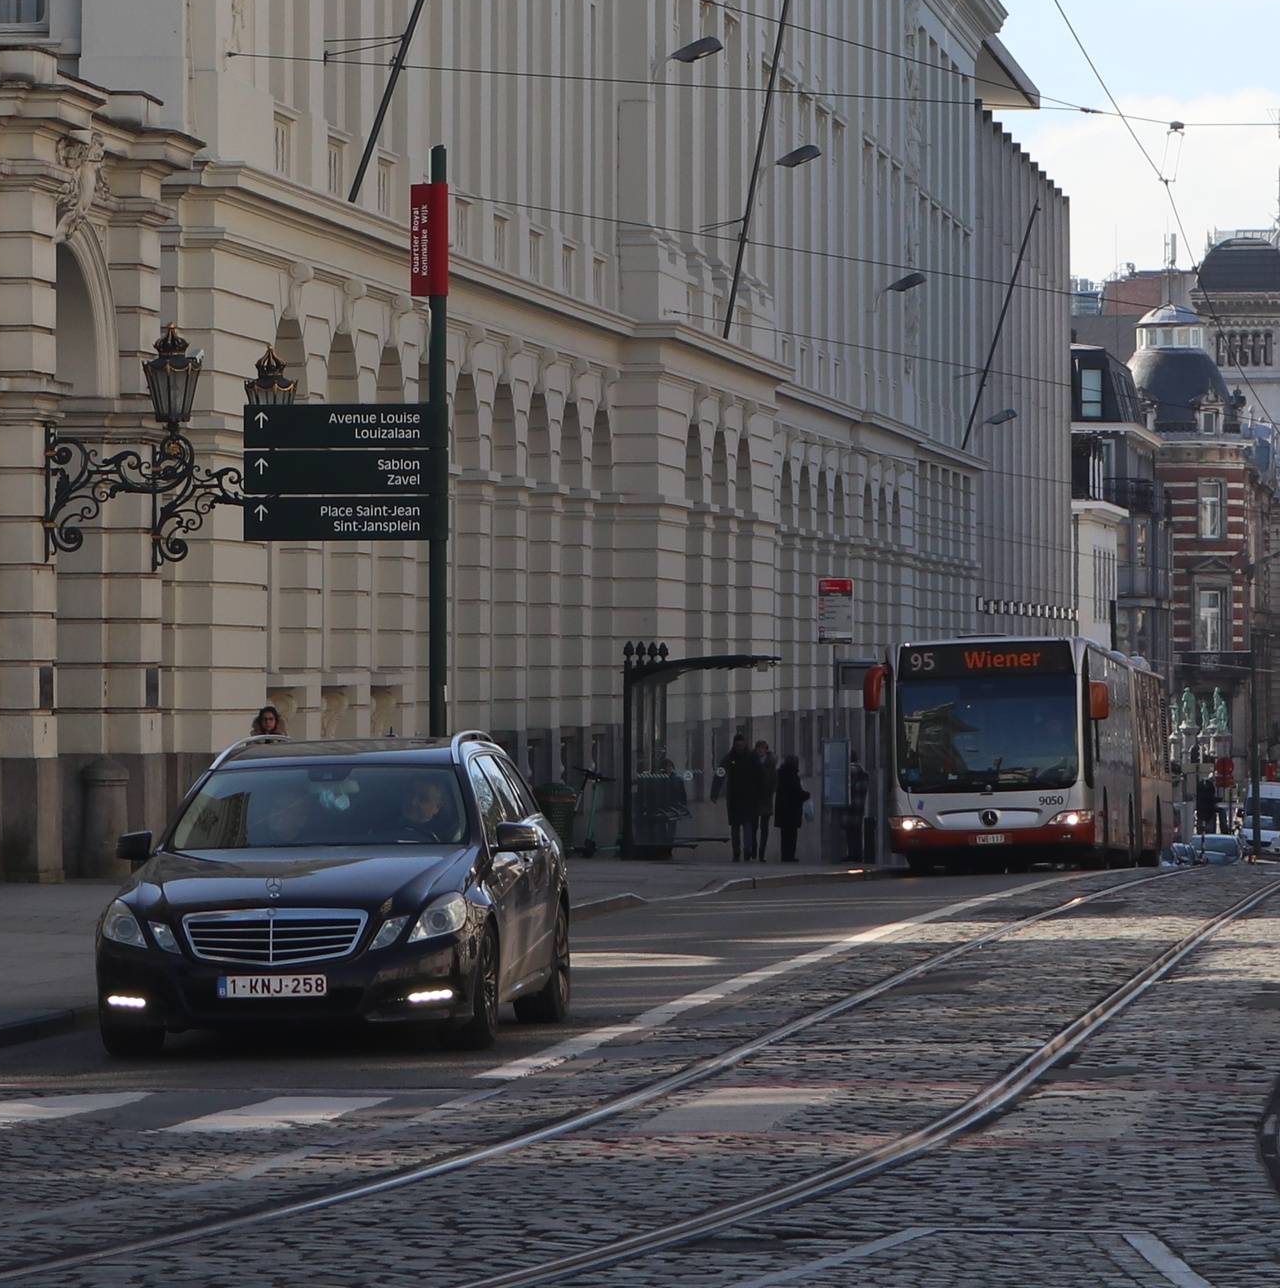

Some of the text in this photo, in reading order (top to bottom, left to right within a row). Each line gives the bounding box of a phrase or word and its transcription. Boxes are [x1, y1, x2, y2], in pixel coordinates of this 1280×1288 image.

[412, 207, 420, 274] Quartier Royal
[328, 412, 421, 424] Avenue Louise
[354, 426, 420, 439] Louizalaan
[377, 458, 420, 470] Sablon
[387, 473, 420, 485] Zavel
[320, 504, 420, 517] Place Saint-Jean
[333, 519, 420, 533] Sint-Jansplein
[910, 650, 1041, 671] 95 Wiener
[1039, 795, 1064, 806] 9050
